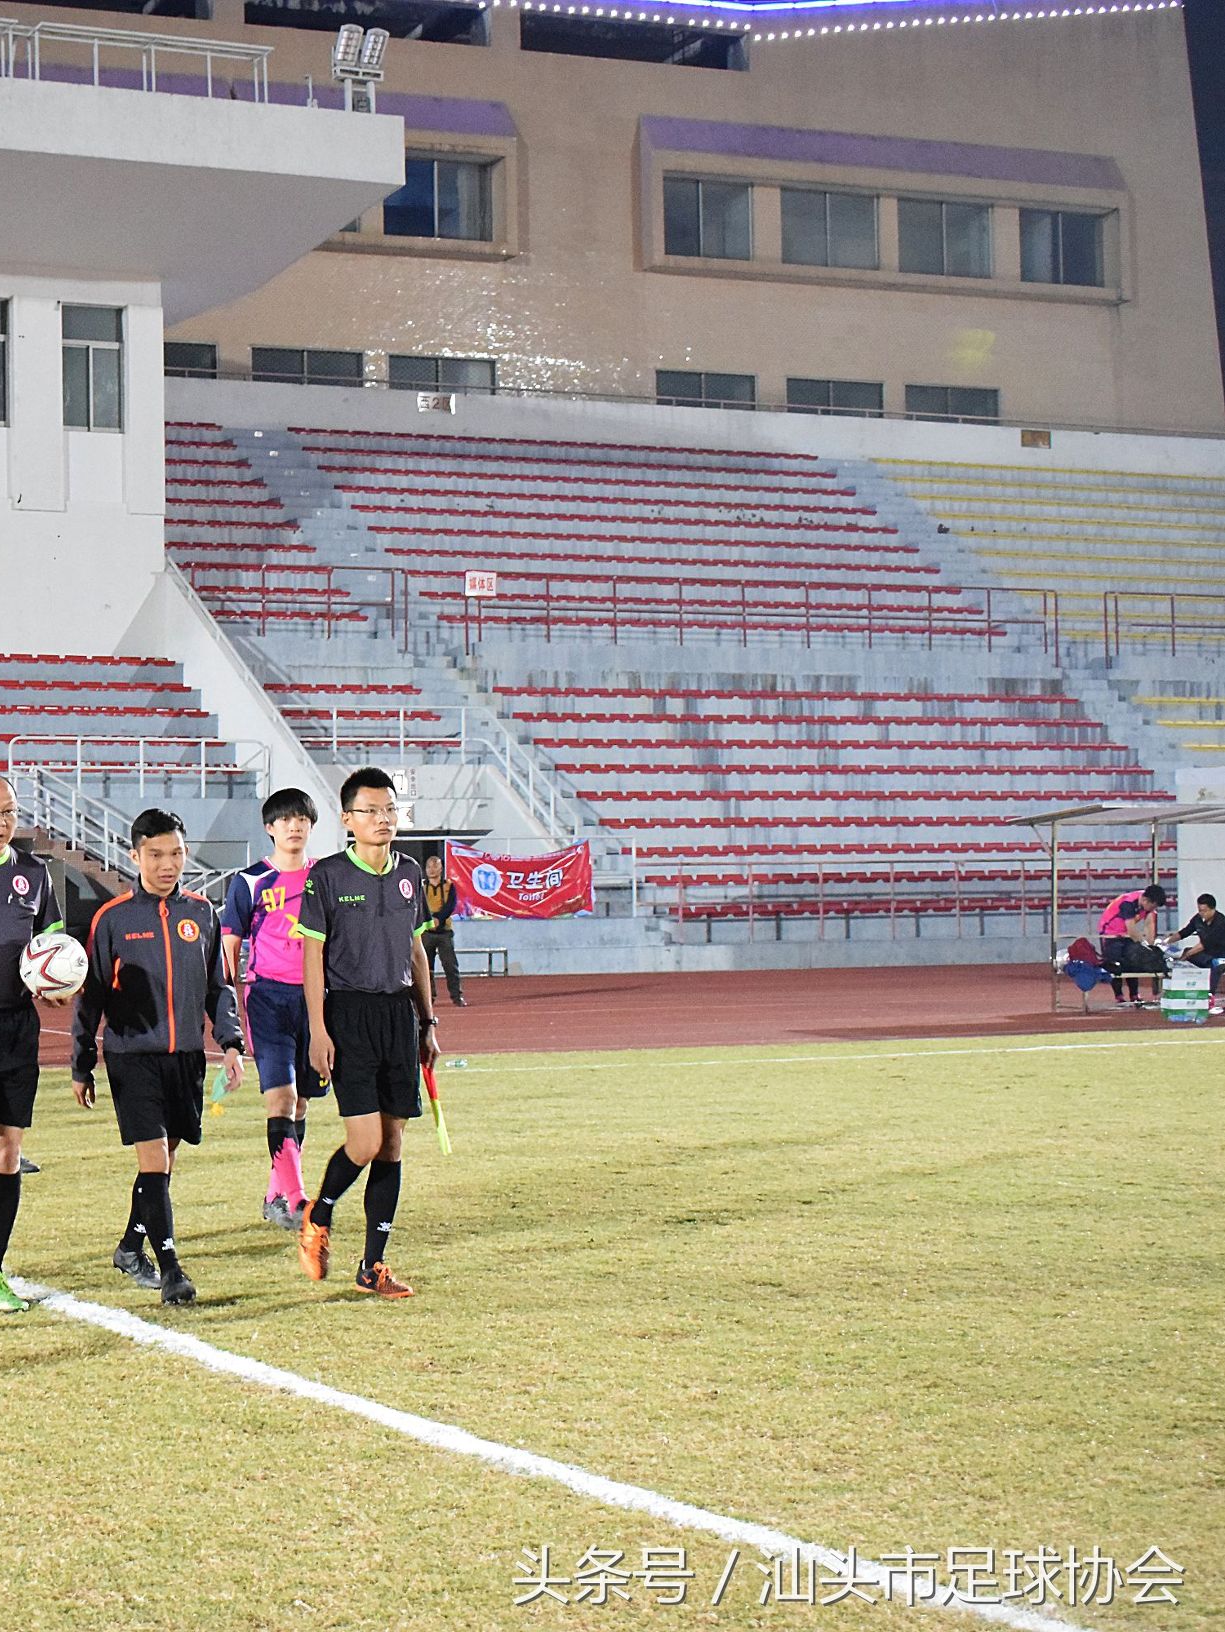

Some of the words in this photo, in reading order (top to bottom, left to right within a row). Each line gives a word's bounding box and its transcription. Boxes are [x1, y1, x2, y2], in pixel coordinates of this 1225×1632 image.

[506, 868, 563, 890] 卫生间
[262, 886, 286, 912] 97
[338, 894, 366, 903] KELME
